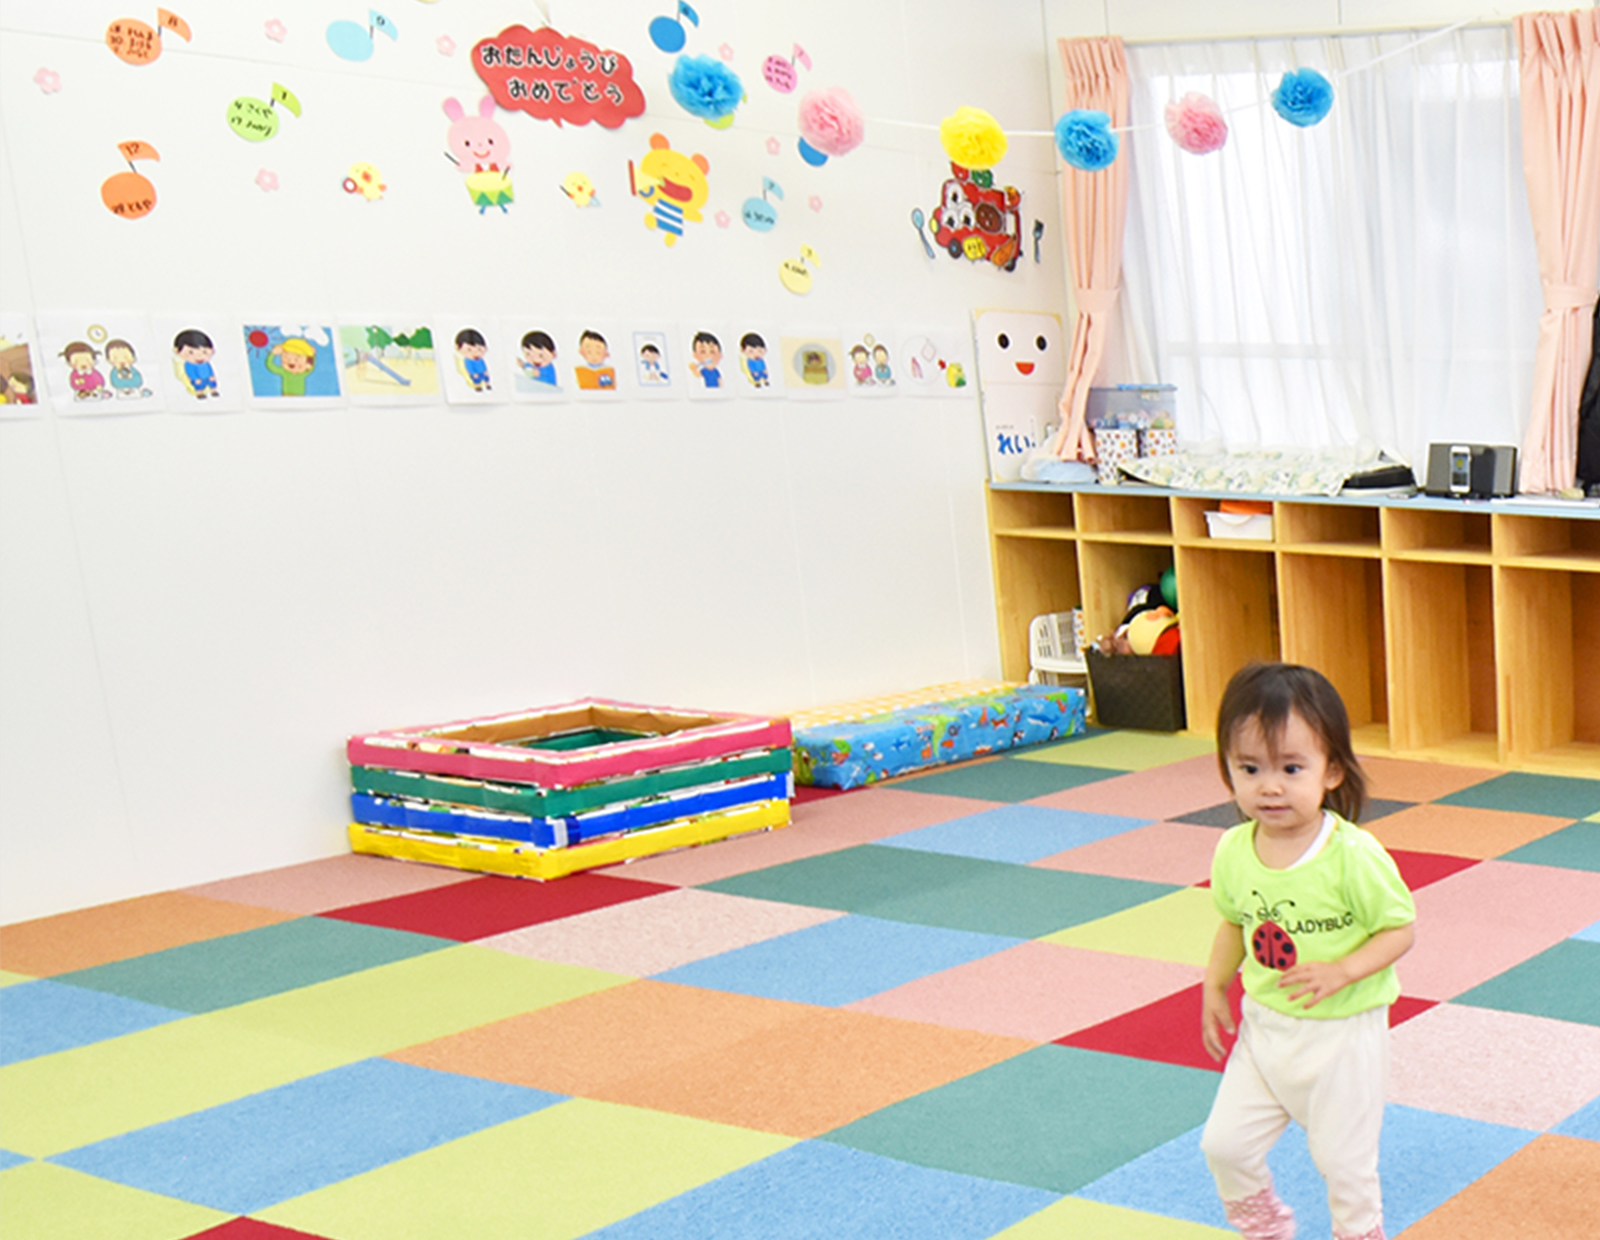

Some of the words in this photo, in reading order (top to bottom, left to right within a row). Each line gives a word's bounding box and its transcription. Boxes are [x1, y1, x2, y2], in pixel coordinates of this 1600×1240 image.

[481, 45, 617, 75] おたんじょうび
[508, 77, 623, 104] おめでとう
[997, 433, 1035, 455] れい
[1285, 912, 1353, 934] LADYBUG
